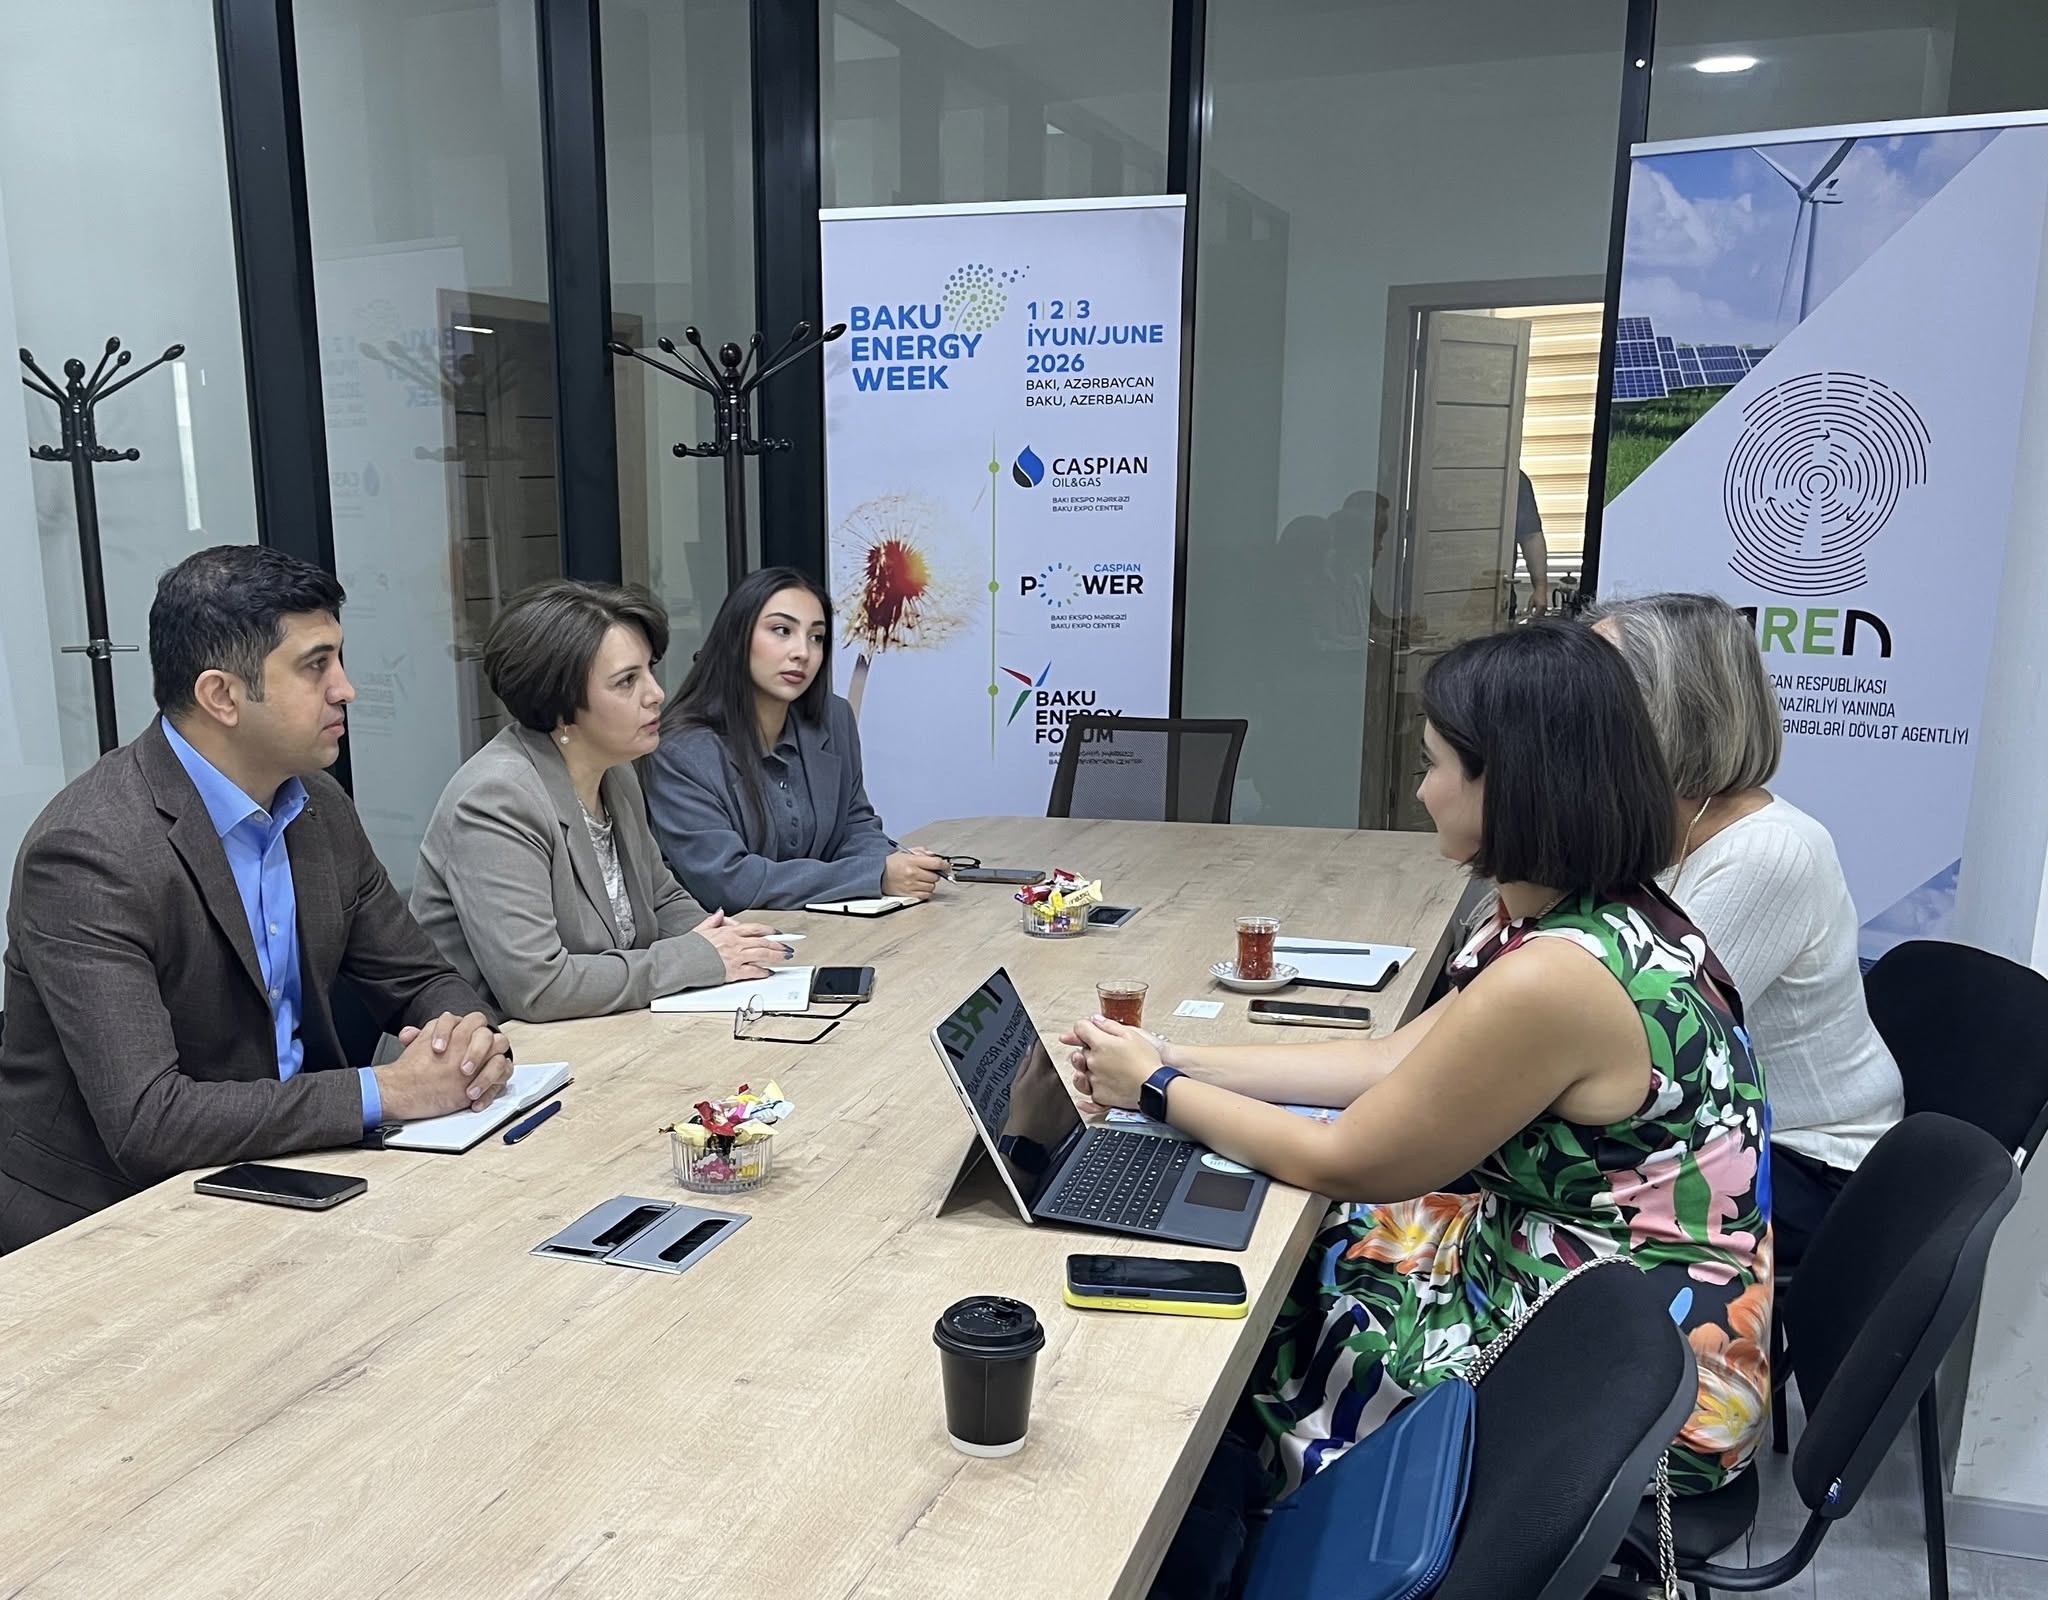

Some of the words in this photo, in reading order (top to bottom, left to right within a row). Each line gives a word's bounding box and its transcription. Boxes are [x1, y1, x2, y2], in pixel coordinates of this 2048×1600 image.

[851, 304, 941, 331] BAKU
[1027, 323, 1164, 347] İYUN/JUNE
[852, 333, 982, 361] ENERGY
[1026, 353, 1085, 373] 2026
[852, 365, 949, 391] WEEK
[1026, 379, 1060, 391] BAKI,
[1063, 376, 1154, 390] AZƏRBAYCAN
[1026, 395, 1066, 407] BAKU,
[1070, 393, 1154, 406] AZERBAIJAN
[1052, 456, 1148, 475] CASPIAN
[1052, 477, 1101, 488] OIL&GAS
[1095, 504, 1124, 512] CENTER
[1093, 563, 1141, 573] CASPIAN
[1796, 675, 1887, 695] RESPUBLİKASI
[1036, 690, 1096, 706] BAKU
[1842, 700, 1895, 718] YANINDA
[1782, 719, 1845, 737] ƏNBƏLƏRİ
